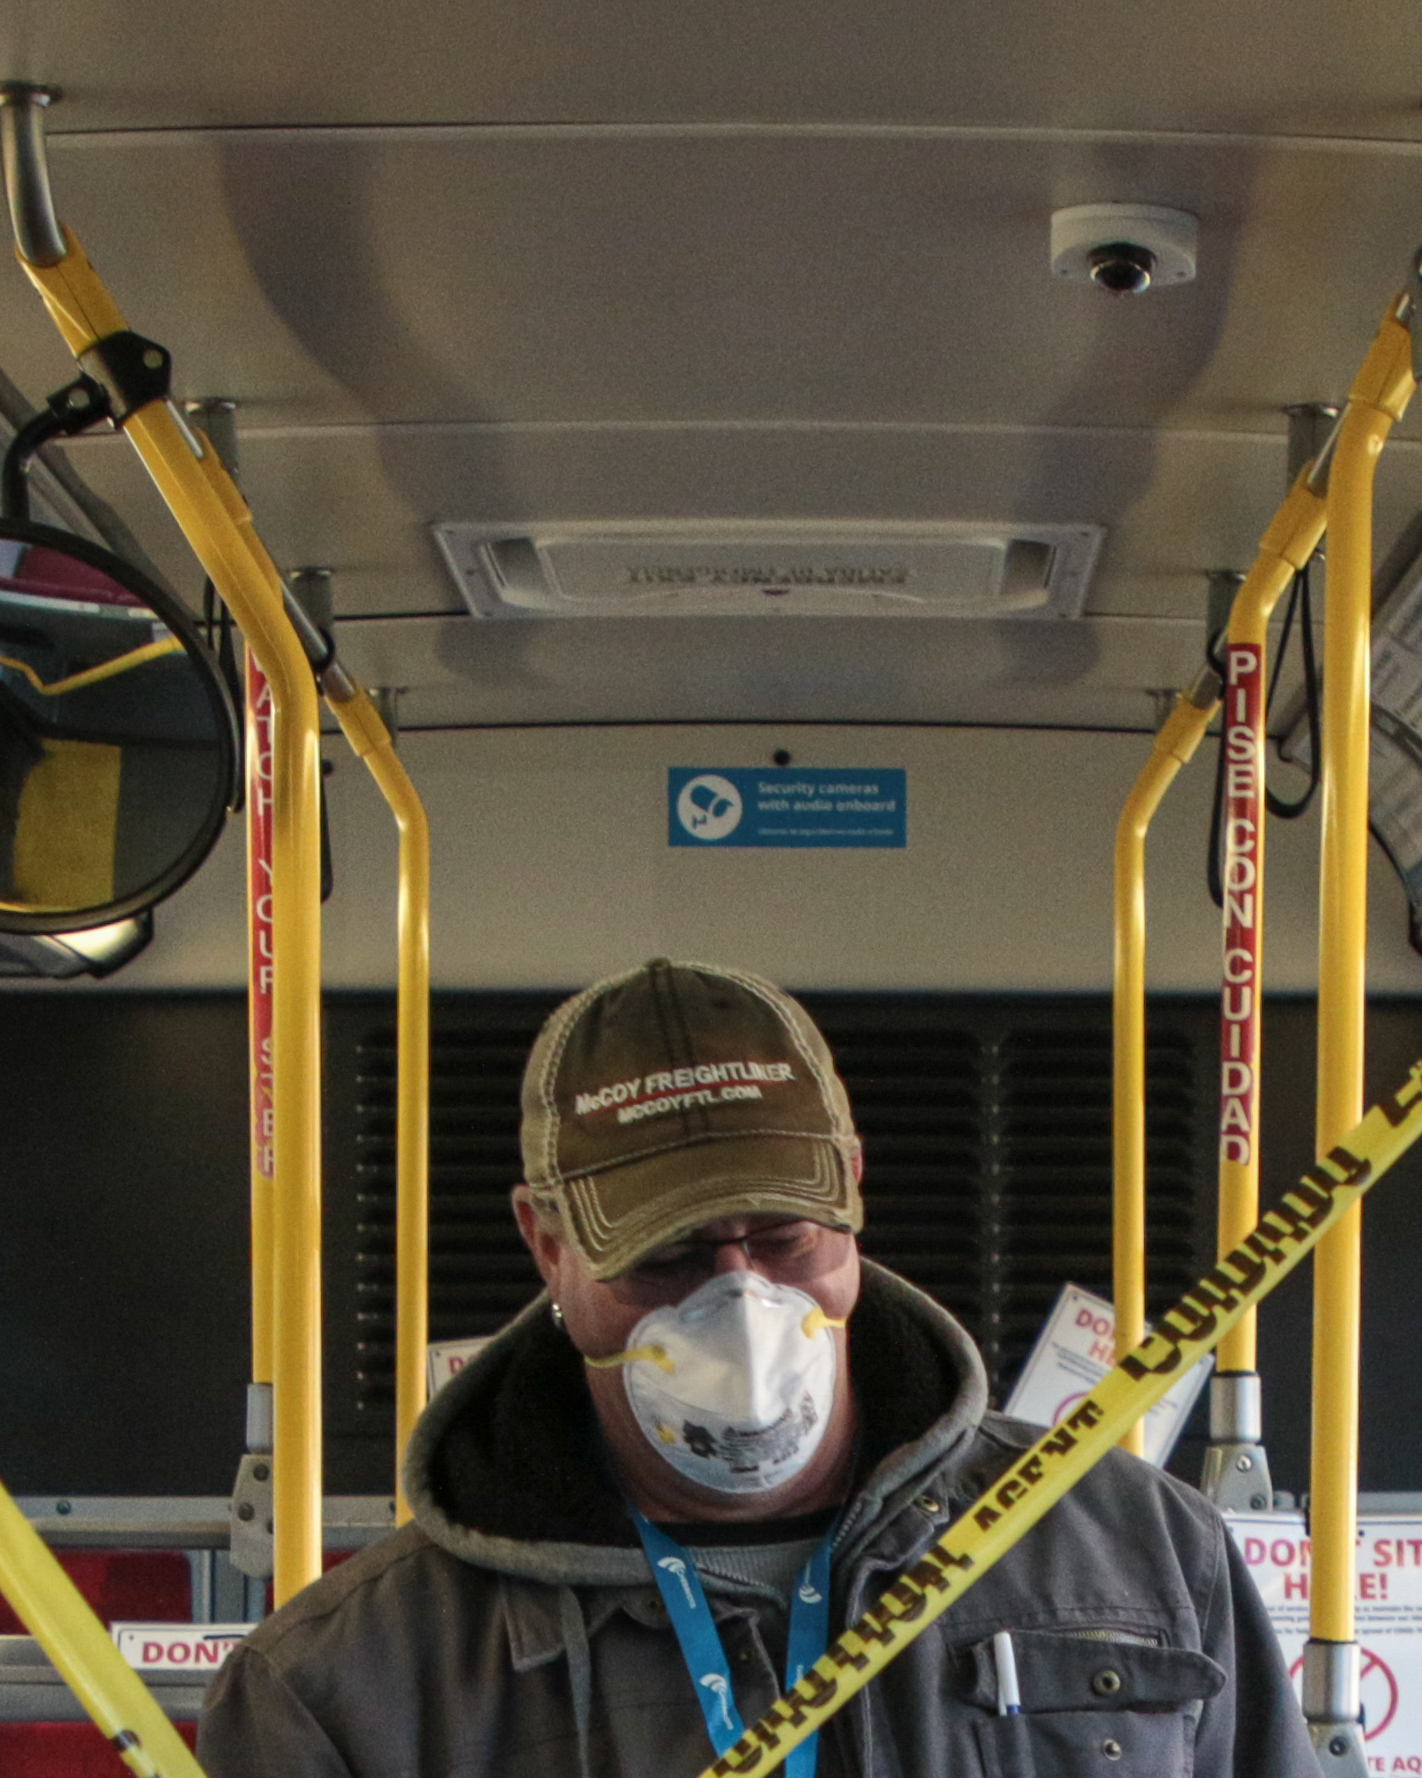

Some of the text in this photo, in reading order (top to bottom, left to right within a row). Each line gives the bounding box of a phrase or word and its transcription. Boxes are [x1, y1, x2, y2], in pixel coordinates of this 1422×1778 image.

[1226, 650, 1258, 799] PISE
[758, 781, 879, 797] Security cameras
[758, 799, 896, 811] with audio onboard
[1223, 817, 1256, 929] CON
[645, 1061, 797, 1095] FREIGHTLINER
[1284, 1573, 1388, 1600] HE!
[142, 1641, 238, 1664] DON'
